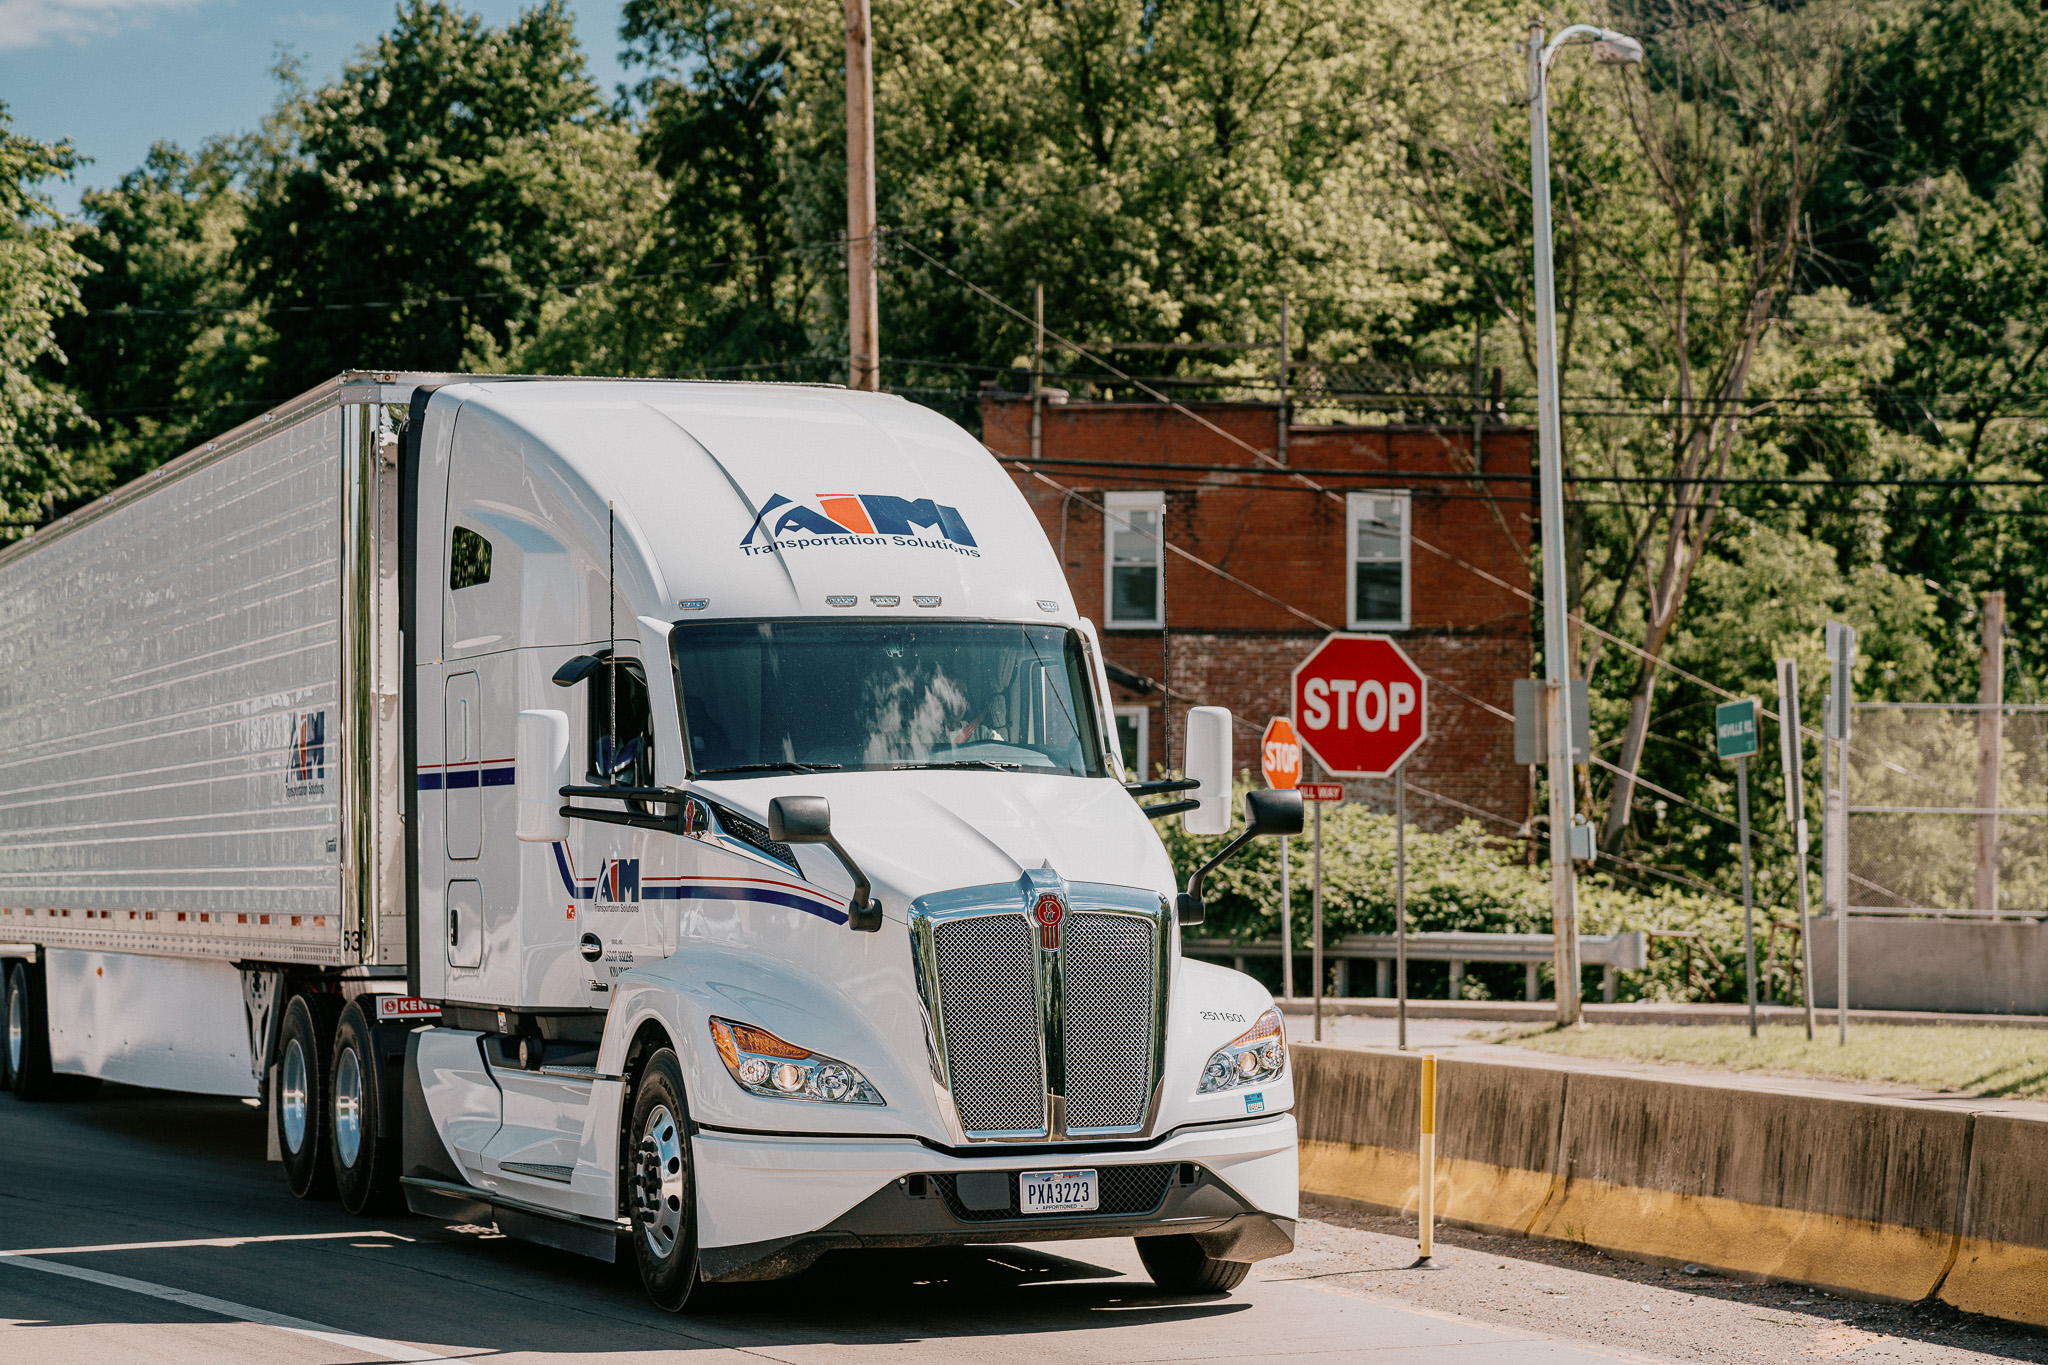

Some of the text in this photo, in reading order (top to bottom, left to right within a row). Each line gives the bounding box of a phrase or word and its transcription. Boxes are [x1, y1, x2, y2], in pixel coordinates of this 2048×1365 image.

[739, 492, 978, 548] AIM
[740, 536, 981, 558] Transportation Solutions
[1303, 677, 1416, 732] STOP
[285, 711, 325, 783] AIM
[1265, 741, 1300, 773] STOP
[1317, 786, 1340, 799] WAY
[594, 857, 640, 903] AIM
[594, 903, 639, 914] Transportation Solutions
[1043, 911, 1056, 922] W
[1045, 903, 1053, 912] K
[1199, 1011, 1246, 1023] 2511601
[1028, 1182, 1089, 1205] PXA3223
